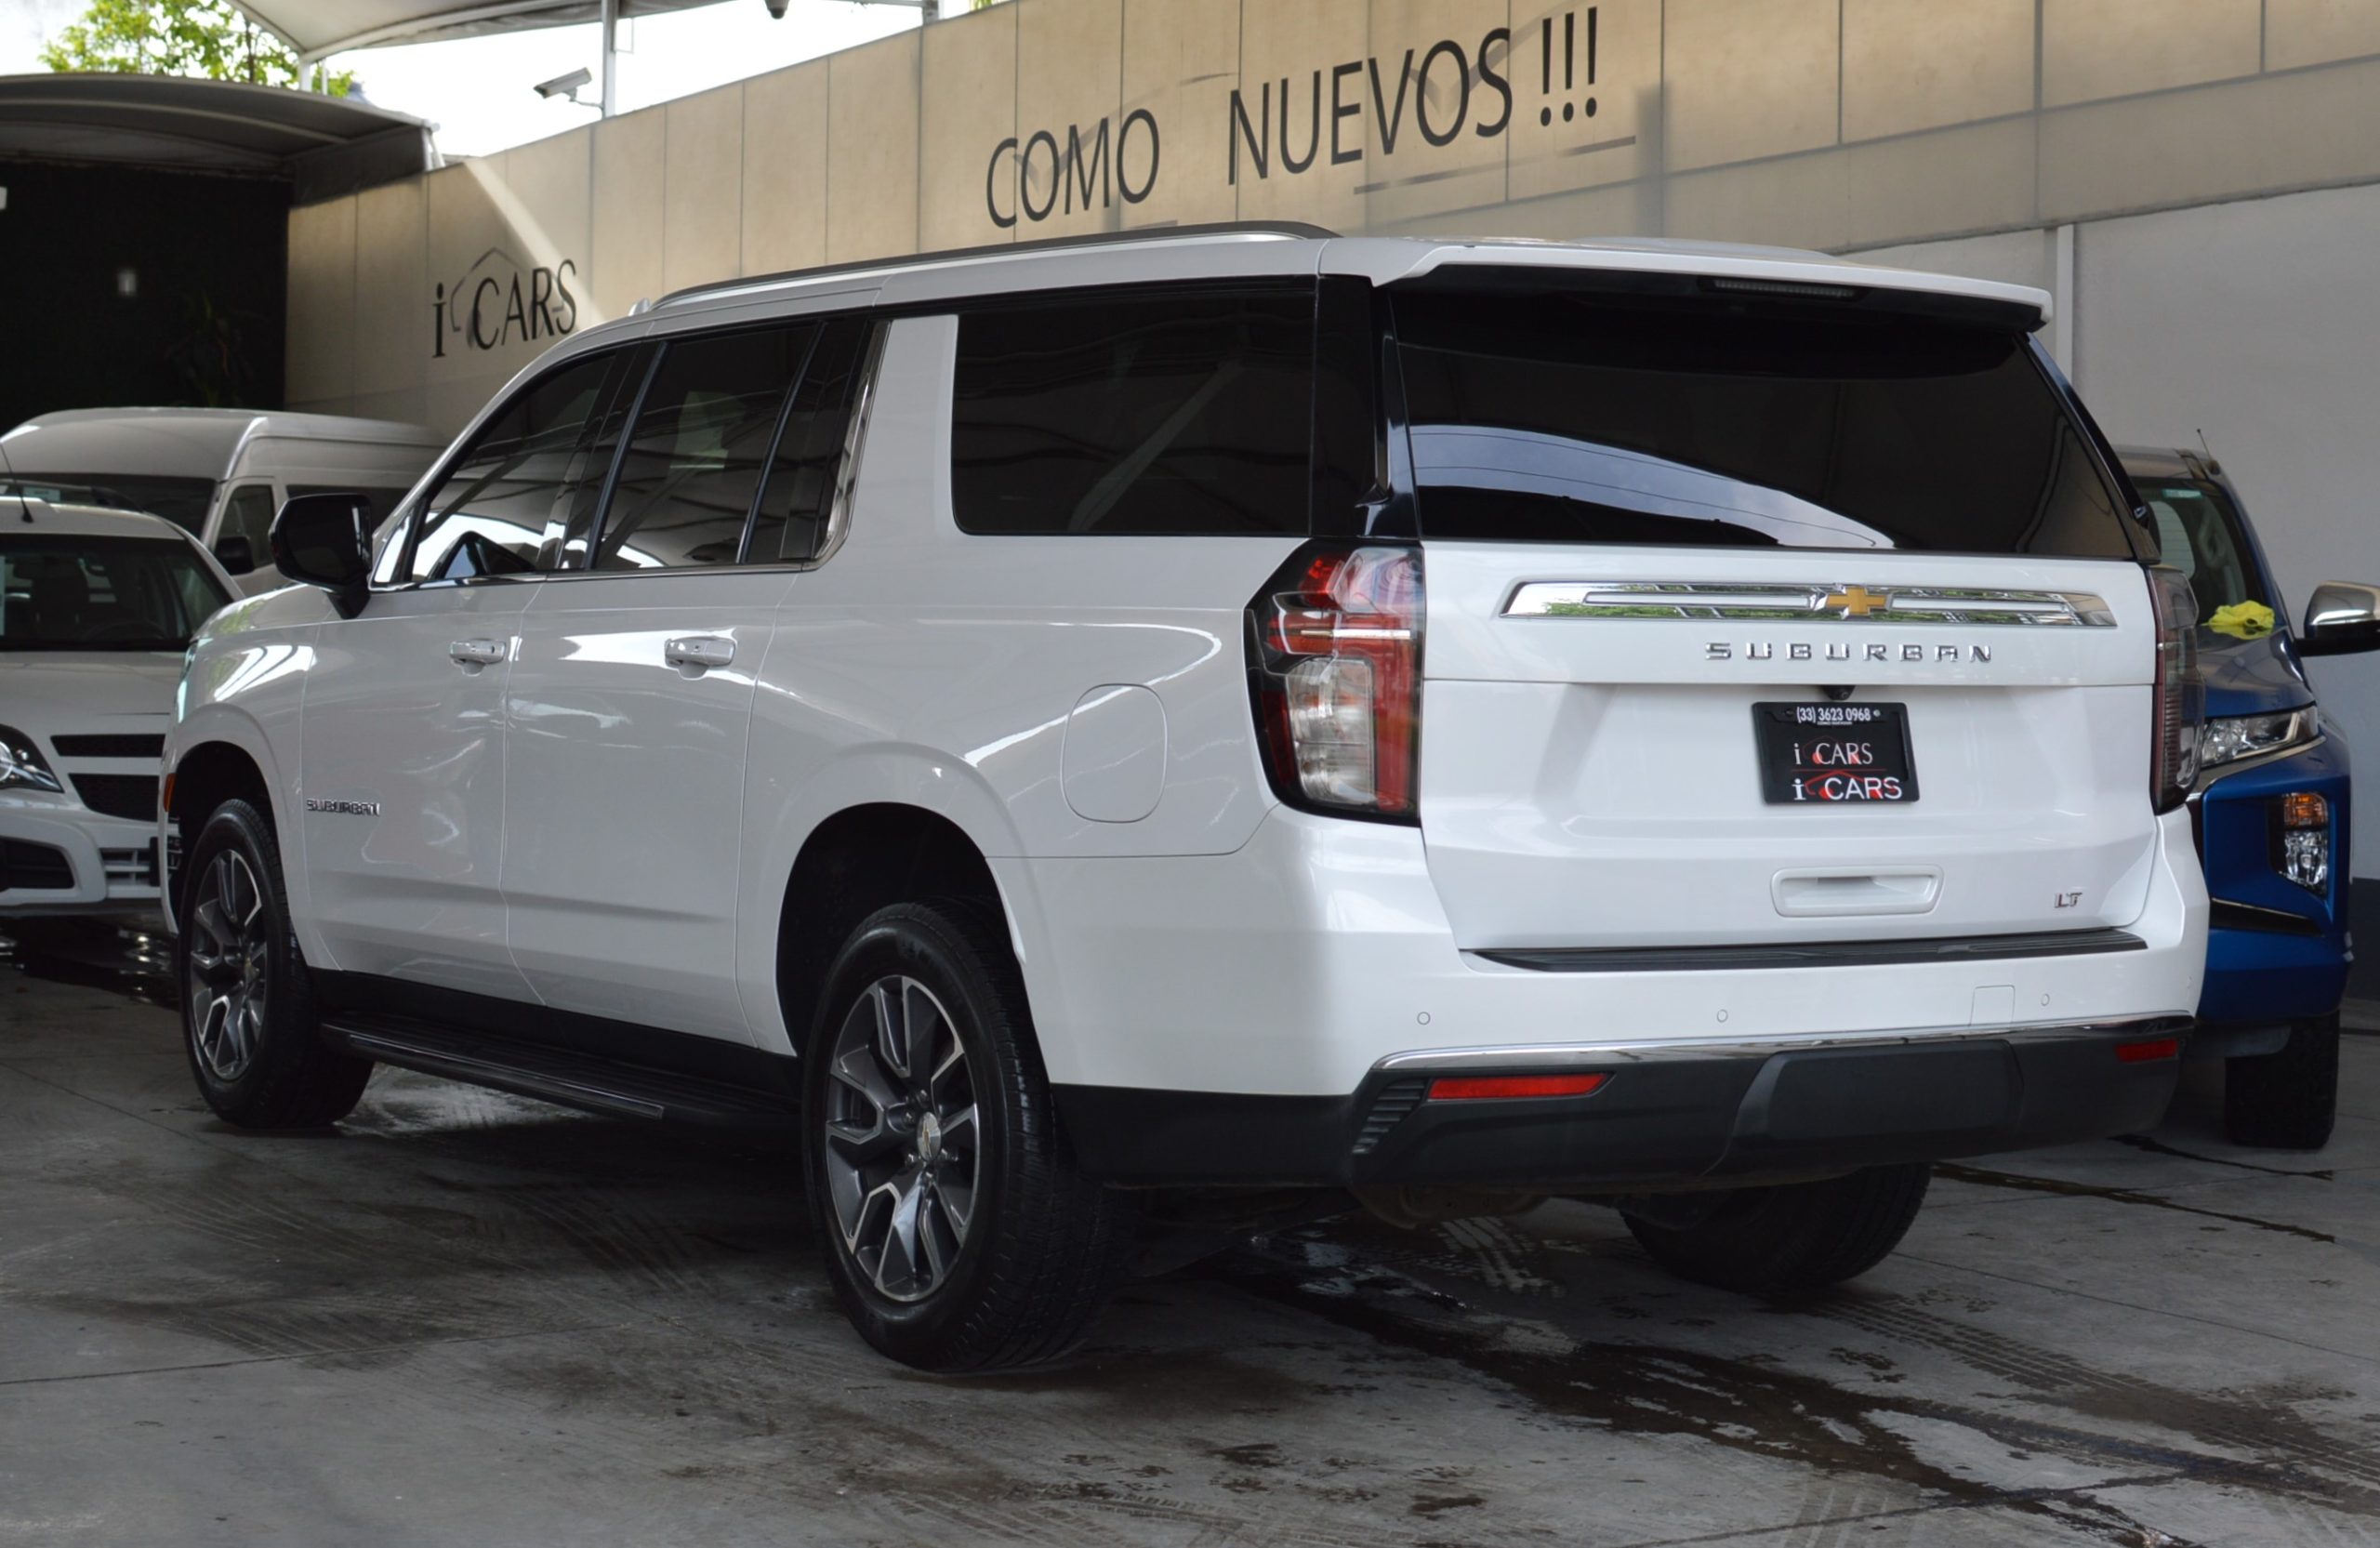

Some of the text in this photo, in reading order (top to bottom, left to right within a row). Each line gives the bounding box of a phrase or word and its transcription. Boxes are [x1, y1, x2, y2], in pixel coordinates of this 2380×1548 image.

[986, 108, 1160, 229] COMO
[1227, 27, 1514, 187] NUEVOS
[472, 258, 577, 351] CARS
[1704, 642, 1992, 663] SUBURBAN
[1796, 707, 1871, 724] (33) 3623 0968
[1816, 743, 1873, 765] CARS
[1824, 776, 1903, 800] CARS
[306, 799, 380, 817] SUBURBAN
[2054, 892, 2083, 908] LT
